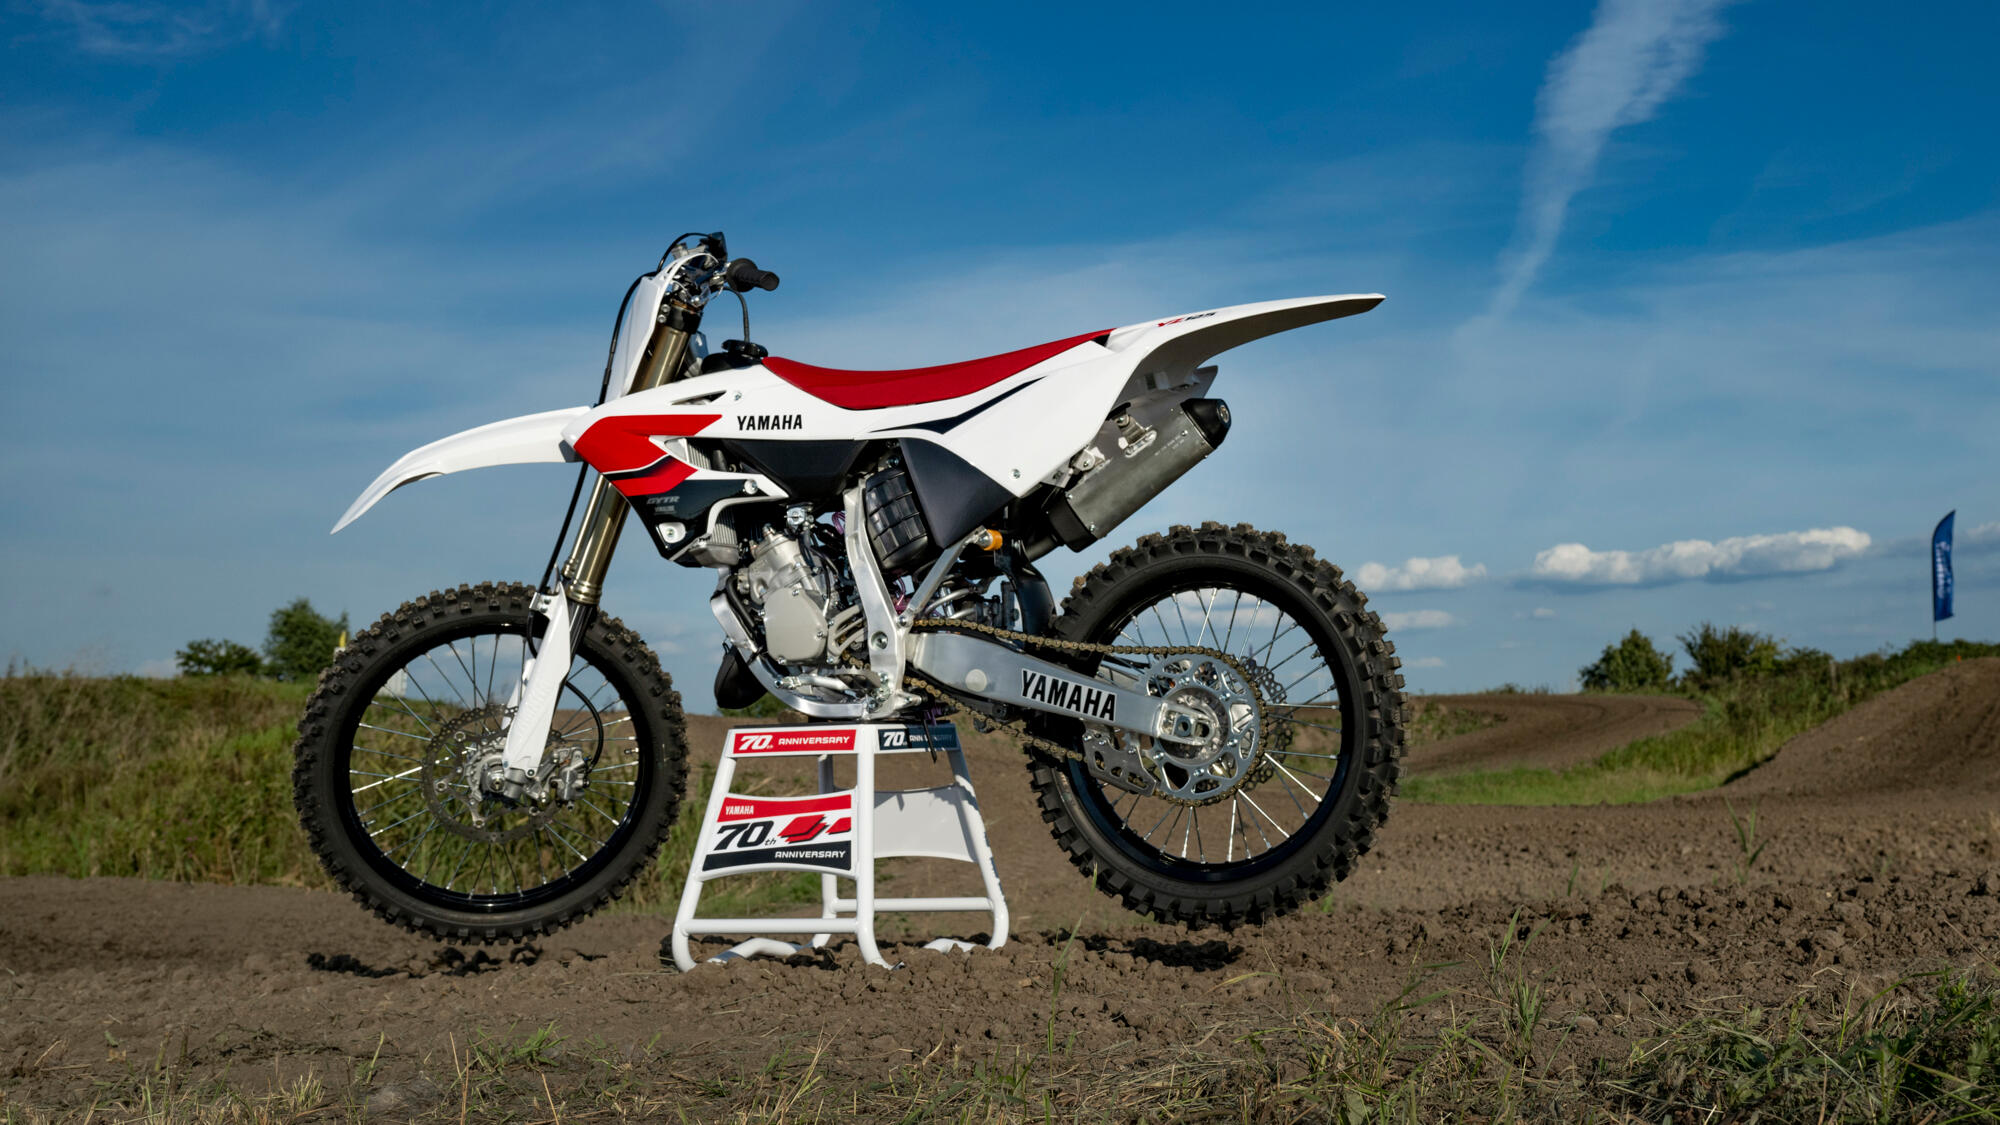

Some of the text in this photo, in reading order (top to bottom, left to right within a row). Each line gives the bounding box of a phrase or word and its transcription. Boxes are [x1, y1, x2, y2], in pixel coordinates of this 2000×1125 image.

[737, 414, 802, 431] YAMAHA
[1022, 670, 1115, 721] YAMAHA
[778, 736, 850, 746] ANNIVERSARY
[725, 805, 754, 815] YAMAHA
[774, 850, 846, 859] ANNIVERSARY
